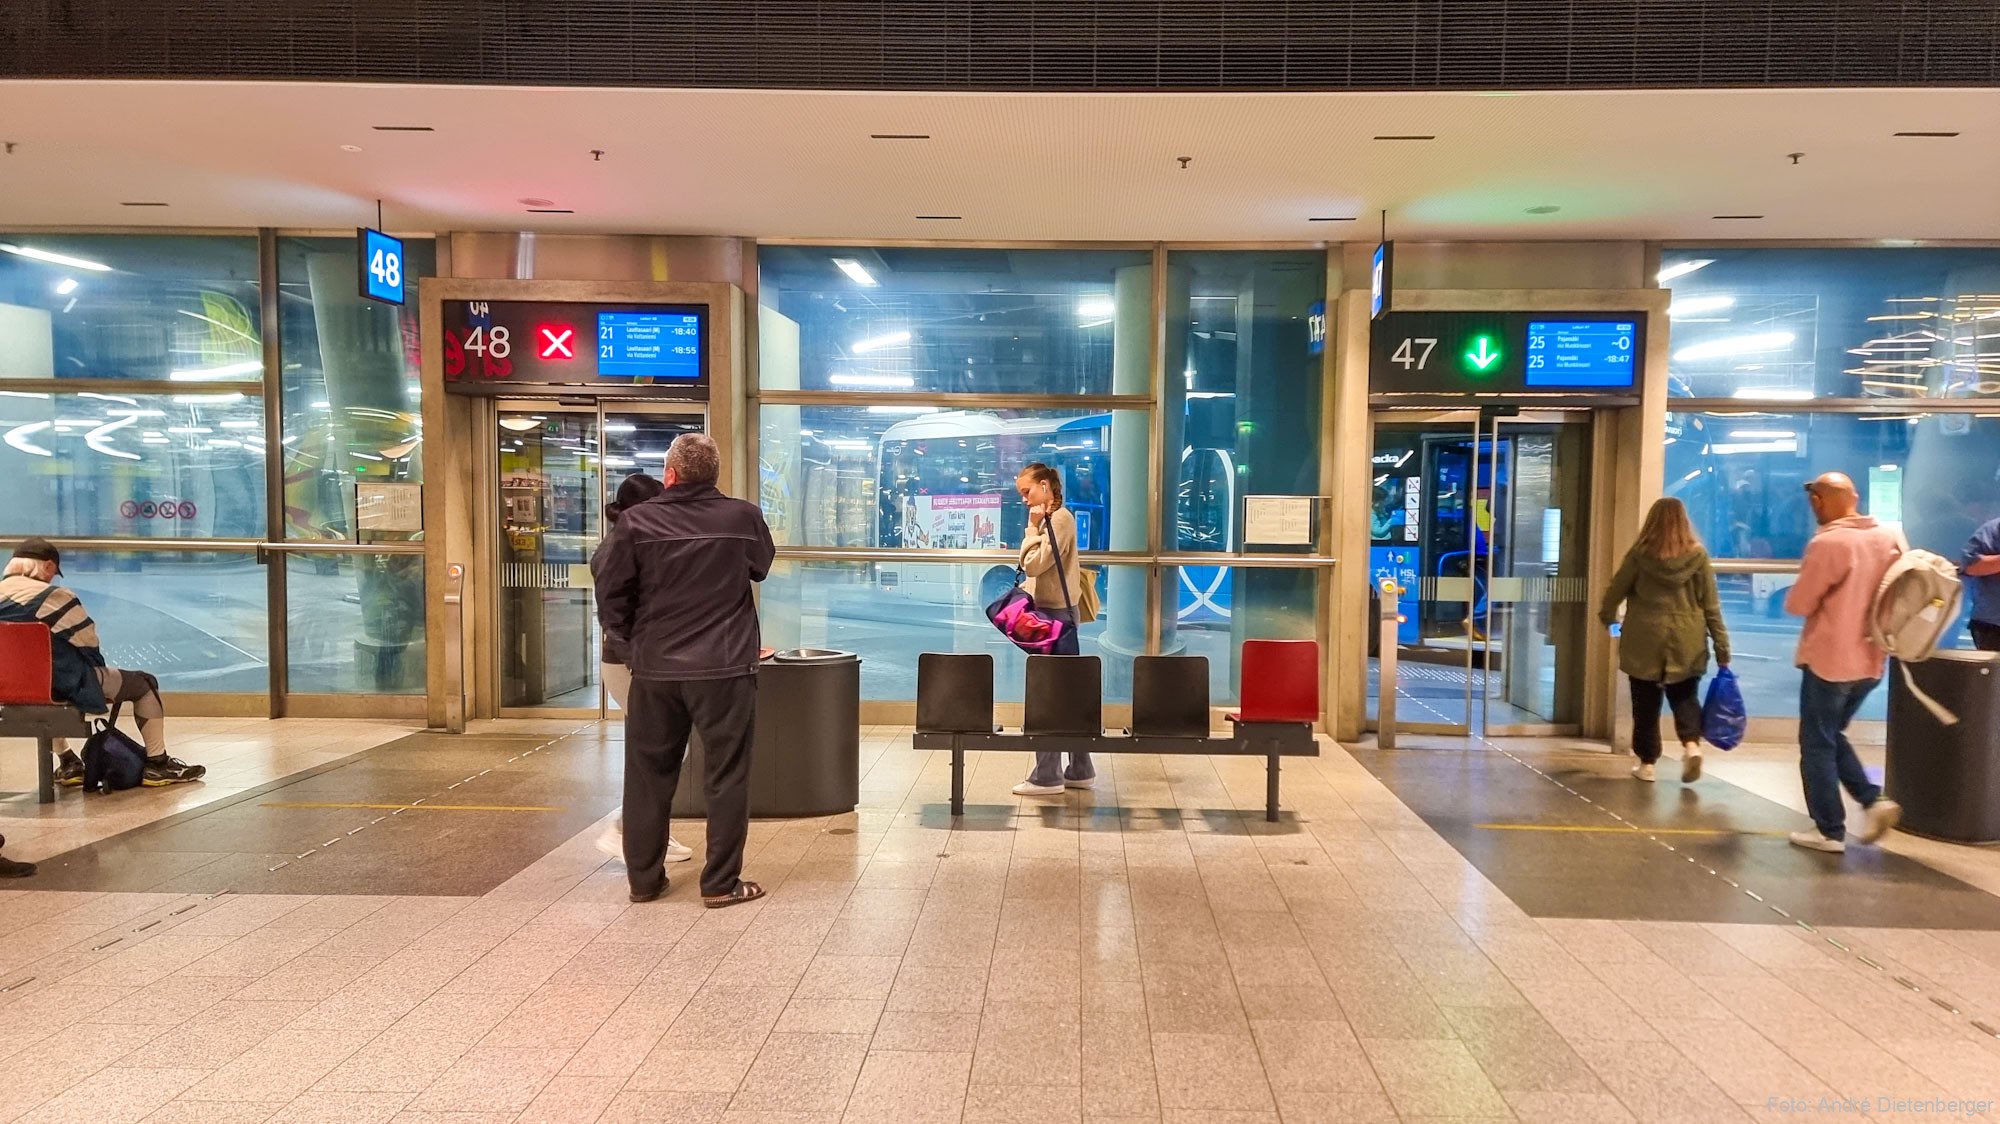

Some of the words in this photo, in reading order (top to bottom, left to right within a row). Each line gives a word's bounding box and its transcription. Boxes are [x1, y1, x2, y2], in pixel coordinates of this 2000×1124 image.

[370, 249, 400, 287] 48
[600, 326, 613, 339] 21
[464, 326, 511, 359] 48
[1530, 336, 1545, 349] 25
[600, 345, 613, 358] 21
[1391, 338, 1438, 370] 47
[1528, 355, 1544, 368] 25
[1400, 569, 1416, 577] HSL
